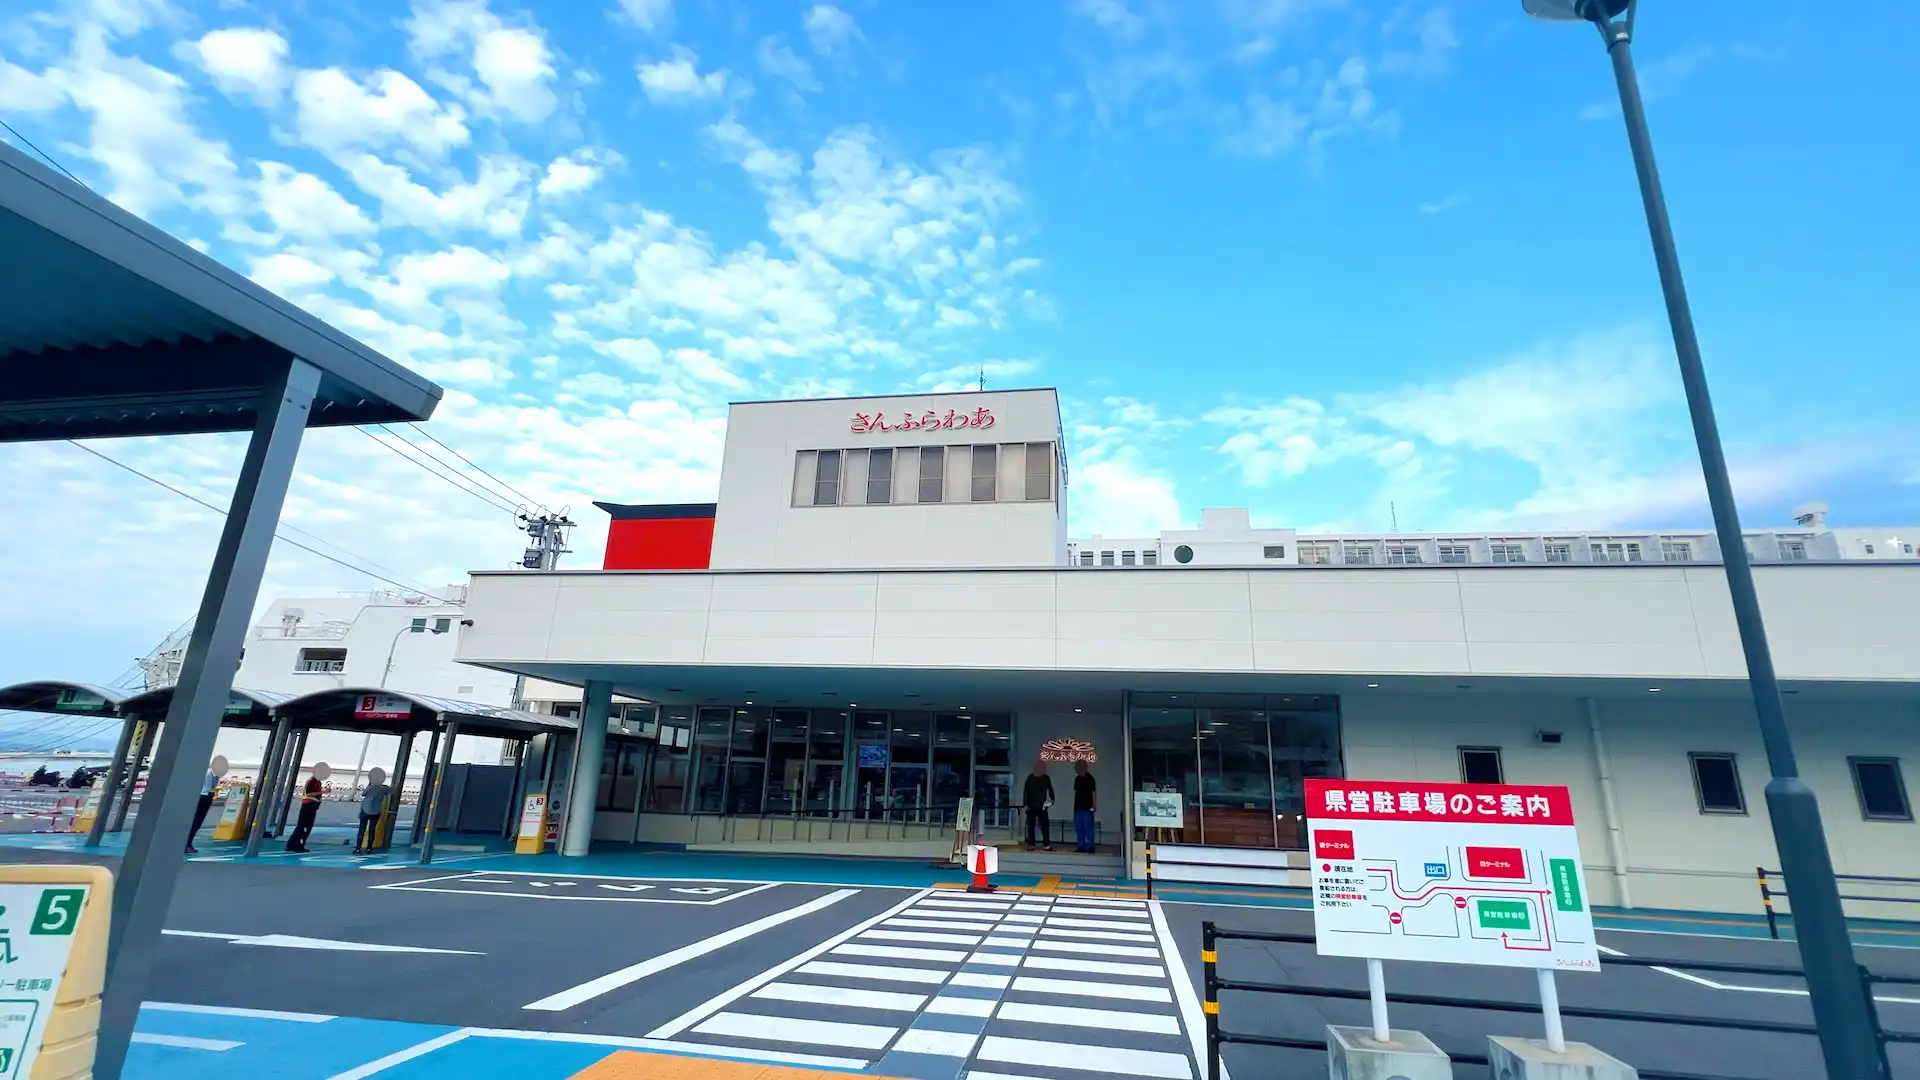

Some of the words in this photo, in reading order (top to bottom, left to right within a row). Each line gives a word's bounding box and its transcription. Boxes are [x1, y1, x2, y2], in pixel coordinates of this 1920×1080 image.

[850, 407, 996, 433] さんふらわあ
[364, 698, 373, 710] 3
[1324, 790, 1551, 818] 県営駐車場のご案内
[1334, 865, 1353, 873] 現在地
[1426, 865, 1445, 875] 出口
[42, 895, 71, 930] 5
